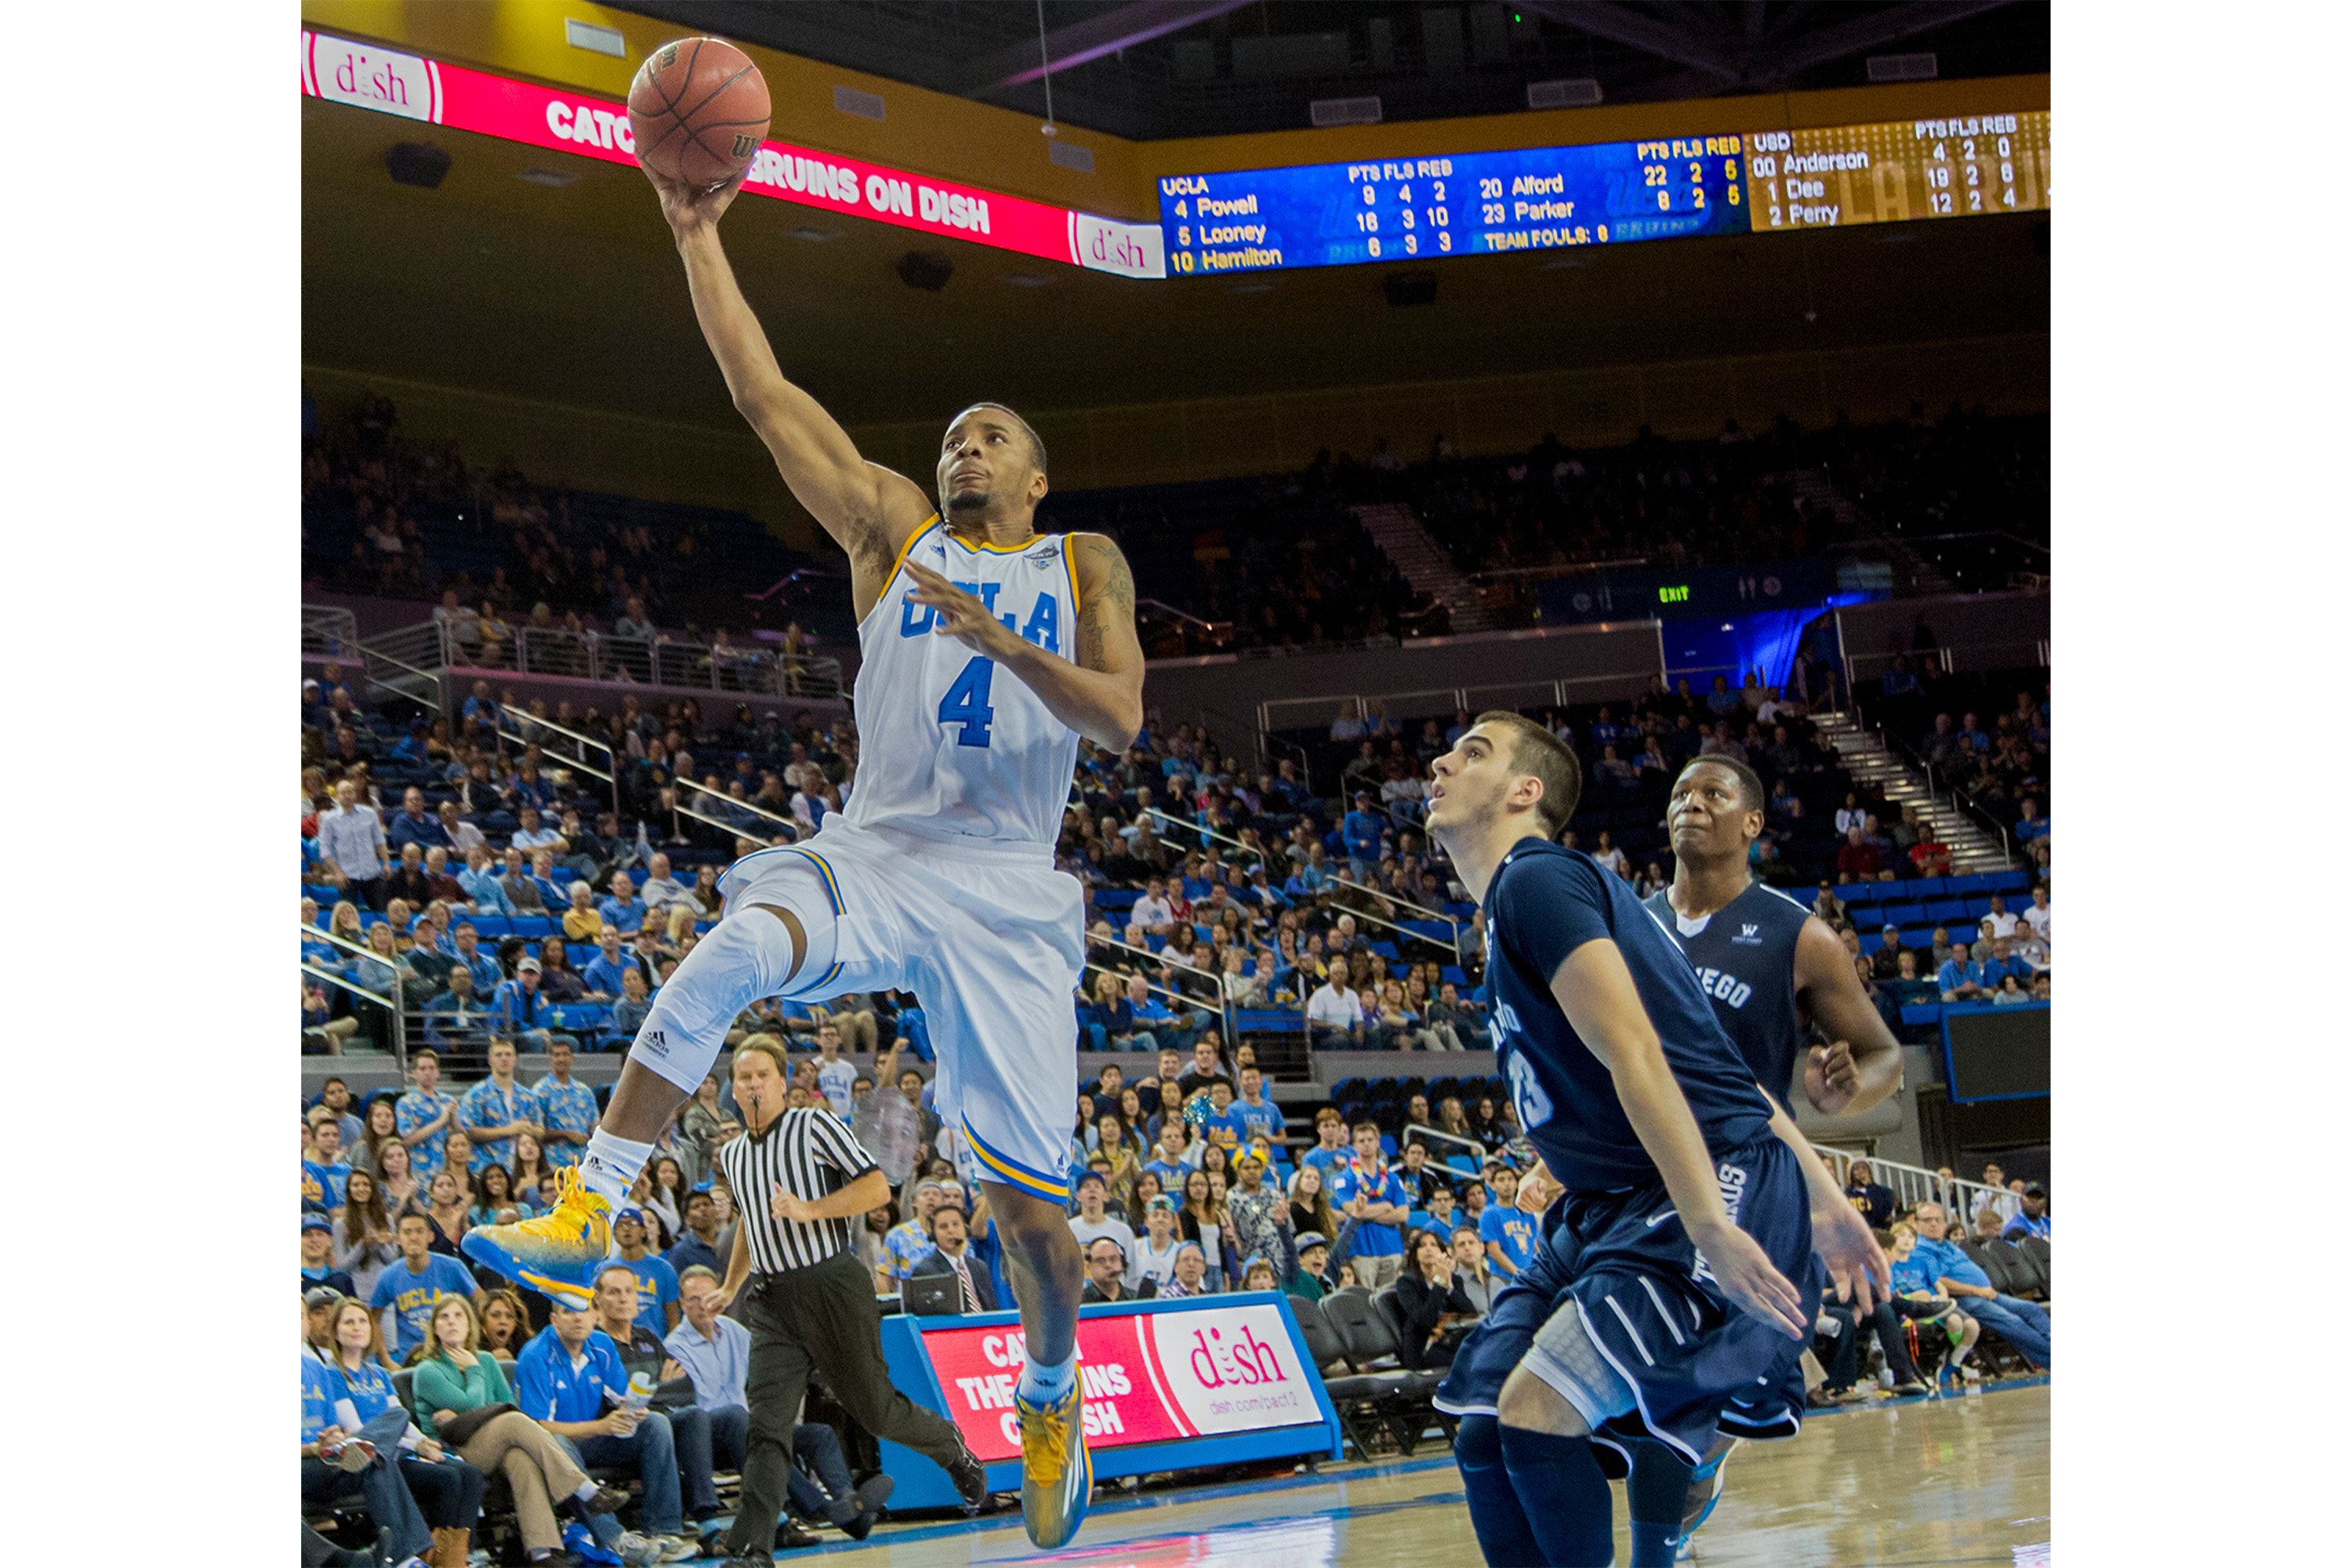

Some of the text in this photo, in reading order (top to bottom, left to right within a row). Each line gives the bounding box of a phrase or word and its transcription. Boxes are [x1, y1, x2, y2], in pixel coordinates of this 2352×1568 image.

[1637, 136, 1740, 162] PTS FLS REB
[1754, 114, 2017, 152] USD PTS FLS REB
[546, 100, 635, 154] CATC
[866, 175, 913, 217] ON
[918, 190, 991, 234] DISH
[1753, 136, 2010, 178] 00 Anderson 4 2 0
[1162, 158, 1453, 196] UCLA PTS FLS REB
[1479, 178, 1502, 199] 20
[1512, 172, 1563, 196] Alford
[1644, 165, 1667, 186] 22
[1690, 162, 1702, 183] 2
[1768, 182, 1777, 201] 1
[1966, 165, 1978, 186] 2
[1174, 199, 1188, 219] 4
[1197, 194, 1258, 218] Powell
[1399, 183, 1411, 203] 4
[1433, 180, 1446, 201] 2
[1483, 203, 1505, 224] 23
[1515, 199, 1574, 221] Parker
[1693, 187, 1704, 208] 2
[1769, 187, 2016, 227] 2 Perry 12 2 4
[1200, 224, 1266, 245] Looney
[1402, 209, 1414, 230] 3
[1427, 206, 1449, 227] 10
[1484, 230, 1529, 250] TEAM
[1531, 226, 1591, 248] FOULS:
[1171, 251, 1194, 272] 10
[1202, 247, 1282, 270] Hamilton
[1404, 234, 1417, 255] 3
[1439, 230, 1451, 252] 3
[1659, 585, 1689, 603] EXIT
[938, 655, 995, 749] 4
[1696, 967, 1751, 1009] EGO
[1191, 1324, 1288, 1389] dish
[955, 1363, 1131, 1410] THE INS
[1000, 1401, 1124, 1446] O SH
